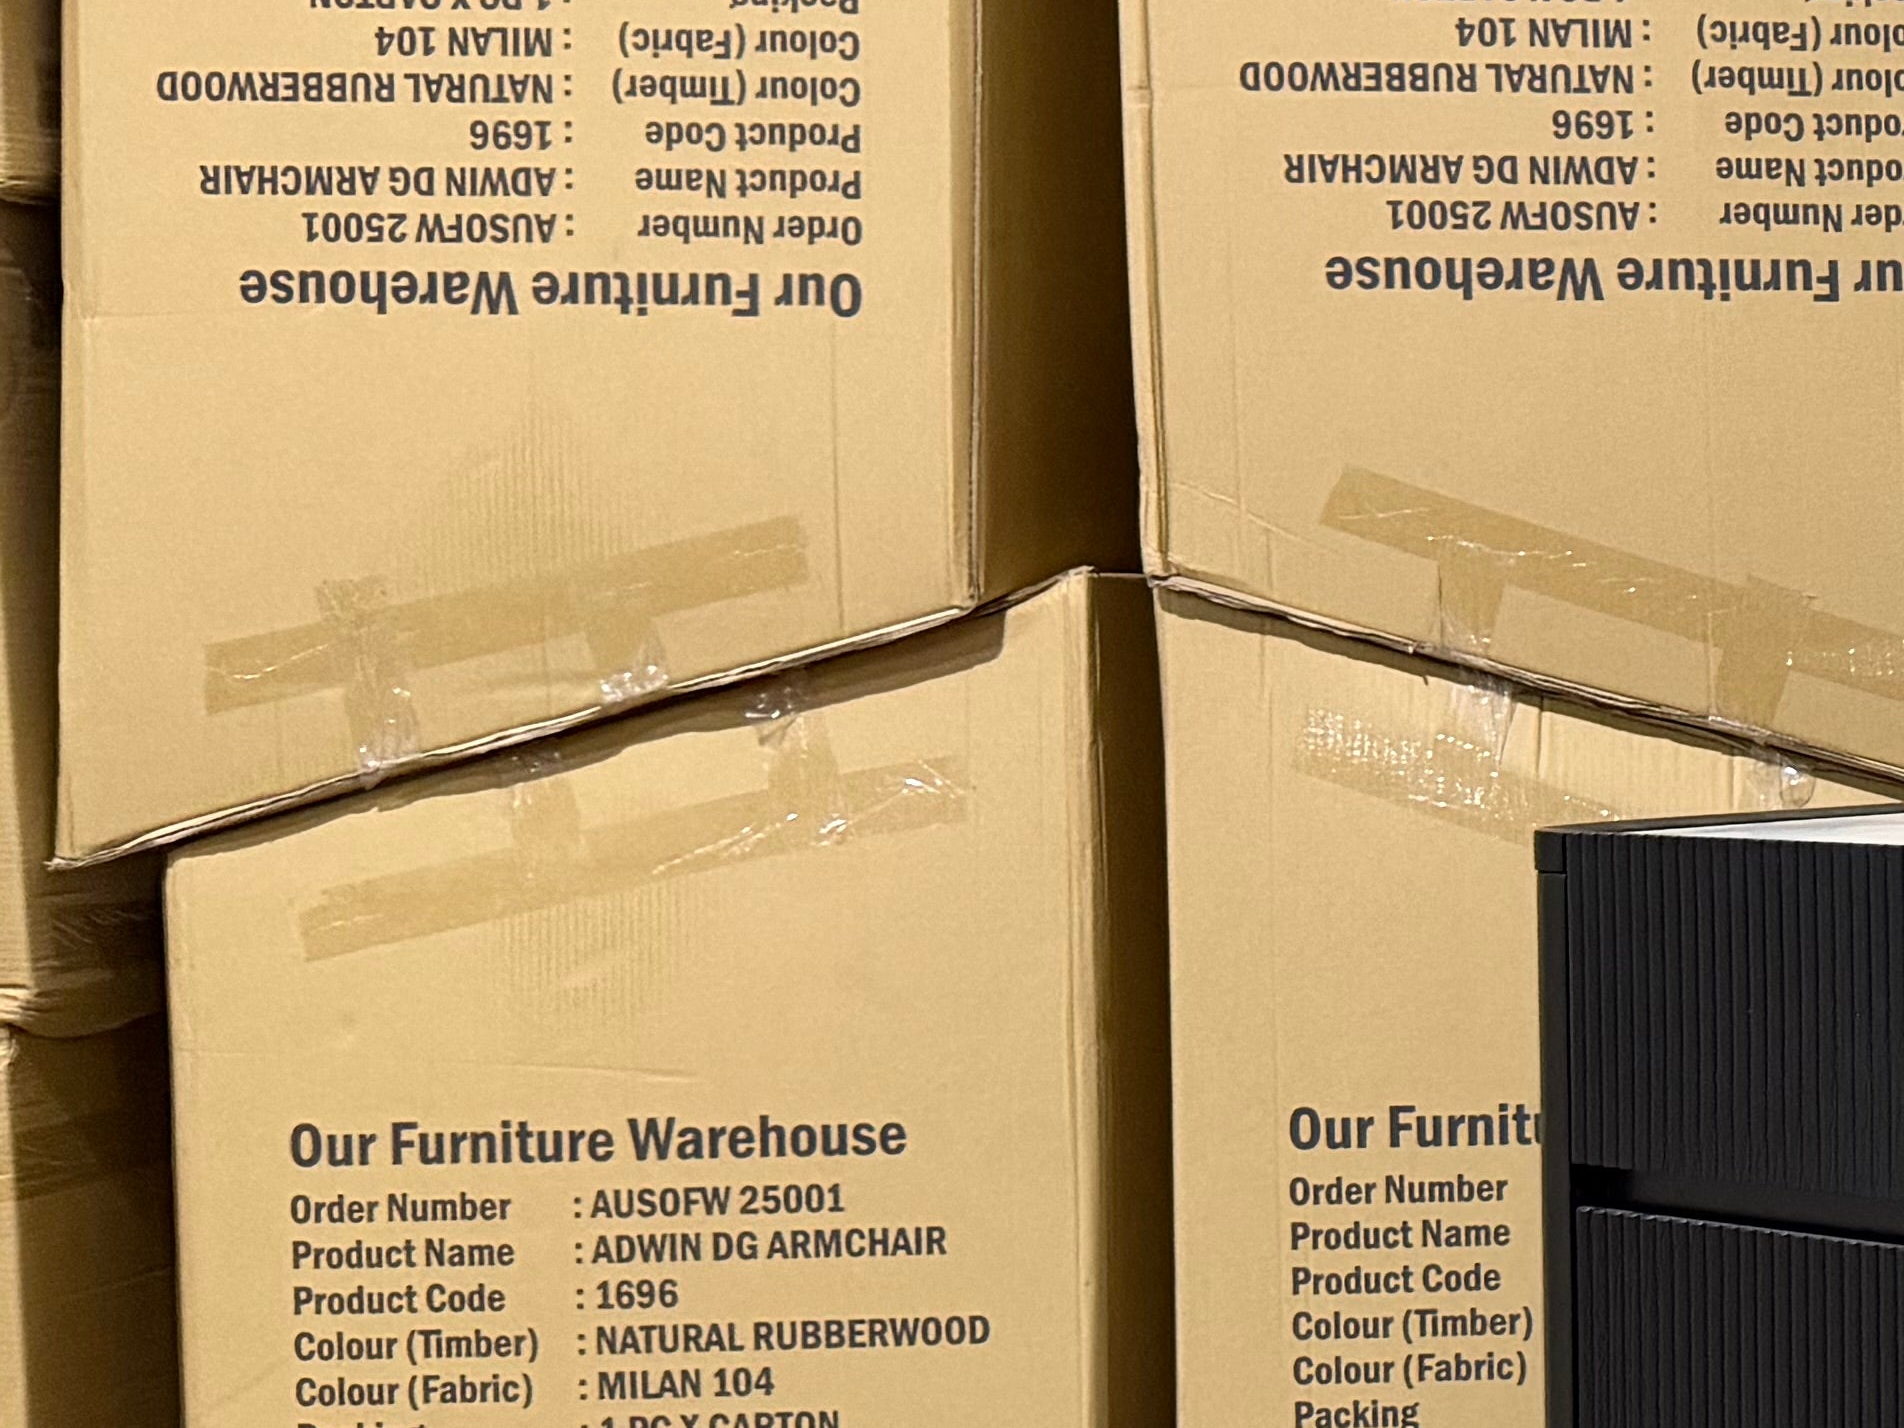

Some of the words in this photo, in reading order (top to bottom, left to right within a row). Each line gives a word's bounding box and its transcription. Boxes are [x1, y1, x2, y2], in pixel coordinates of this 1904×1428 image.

[374, 26, 435, 56] 104
[449, 27, 552, 57] MILAN
[619, 21, 746, 59] (Fabric)
[755, 30, 860, 61] Colour
[157, 71, 395, 102] RUBBERWOOD
[404, 73, 553, 104] NATURAL
[612, 68, 746, 106] (Timber)
[755, 77, 861, 107] Colour
[1240, 62, 1477, 92] RUBBERWOOD
[1485, 64, 1633, 94] NATURAL
[1692, 59, 1822, 97] (Timber)
[470, 120, 552, 150] 1696
[645, 122, 726, 152] Code
[734, 123, 860, 153] Product
[199, 165, 380, 195] ARMCHAIR
[389, 167, 434, 196] DG
[446, 167, 556, 196] ADWIN
[635, 168, 726, 198] Name
[735, 169, 861, 199] Product
[1283, 154, 1464, 184] ARMCHAIR
[1473, 155, 1518, 184] DG
[1529, 156, 1638, 185] ADWIN
[1716, 157, 1805, 187] Name
[1386, 200, 1491, 230] 25001
[1500, 201, 1640, 230] AUSOFW
[1719, 203, 1842, 232] Number
[239, 270, 519, 315] Warehouse
[532, 271, 759, 317] Furniture
[1325, 256, 1604, 301] Warehouse
[1617, 258, 1839, 302] Furniture
[774, 273, 862, 317] Our
[290, 1123, 377, 1167] Our
[392, 1120, 614, 1165] Furniture
[627, 1115, 907, 1161] Warehouse
[1290, 1107, 1374, 1150] Our
[291, 1194, 379, 1224] Order
[388, 1192, 512, 1222] Number
[590, 1186, 731, 1218] AUSOFW
[739, 1183, 845, 1214] 25001
[1289, 1176, 1377, 1206] Order
[1385, 1174, 1508, 1203] Number
[292, 1239, 416, 1269] Product
[425, 1238, 515, 1267] Name
[591, 1233, 701, 1264] ADWIN
[713, 1231, 758, 1261] DG
[766, 1226, 947, 1259] ARMCHAIR
[1291, 1221, 1413, 1250] Product
[1422, 1219, 1510, 1247] Name
[1292, 1265, 1414, 1296] Product
[1422, 1263, 1501, 1292] Code
[294, 1285, 418, 1315] Product
[426, 1283, 505, 1313] Code
[596, 1279, 678, 1309] 1696
[294, 1332, 398, 1361] Colour
[407, 1327, 538, 1366] (Timber)
[596, 1323, 745, 1355] NATURAL
[754, 1315, 990, 1350] RUBBERWOOD
[1292, 1311, 1394, 1340] Colour
[1402, 1306, 1532, 1344] (Timber)
